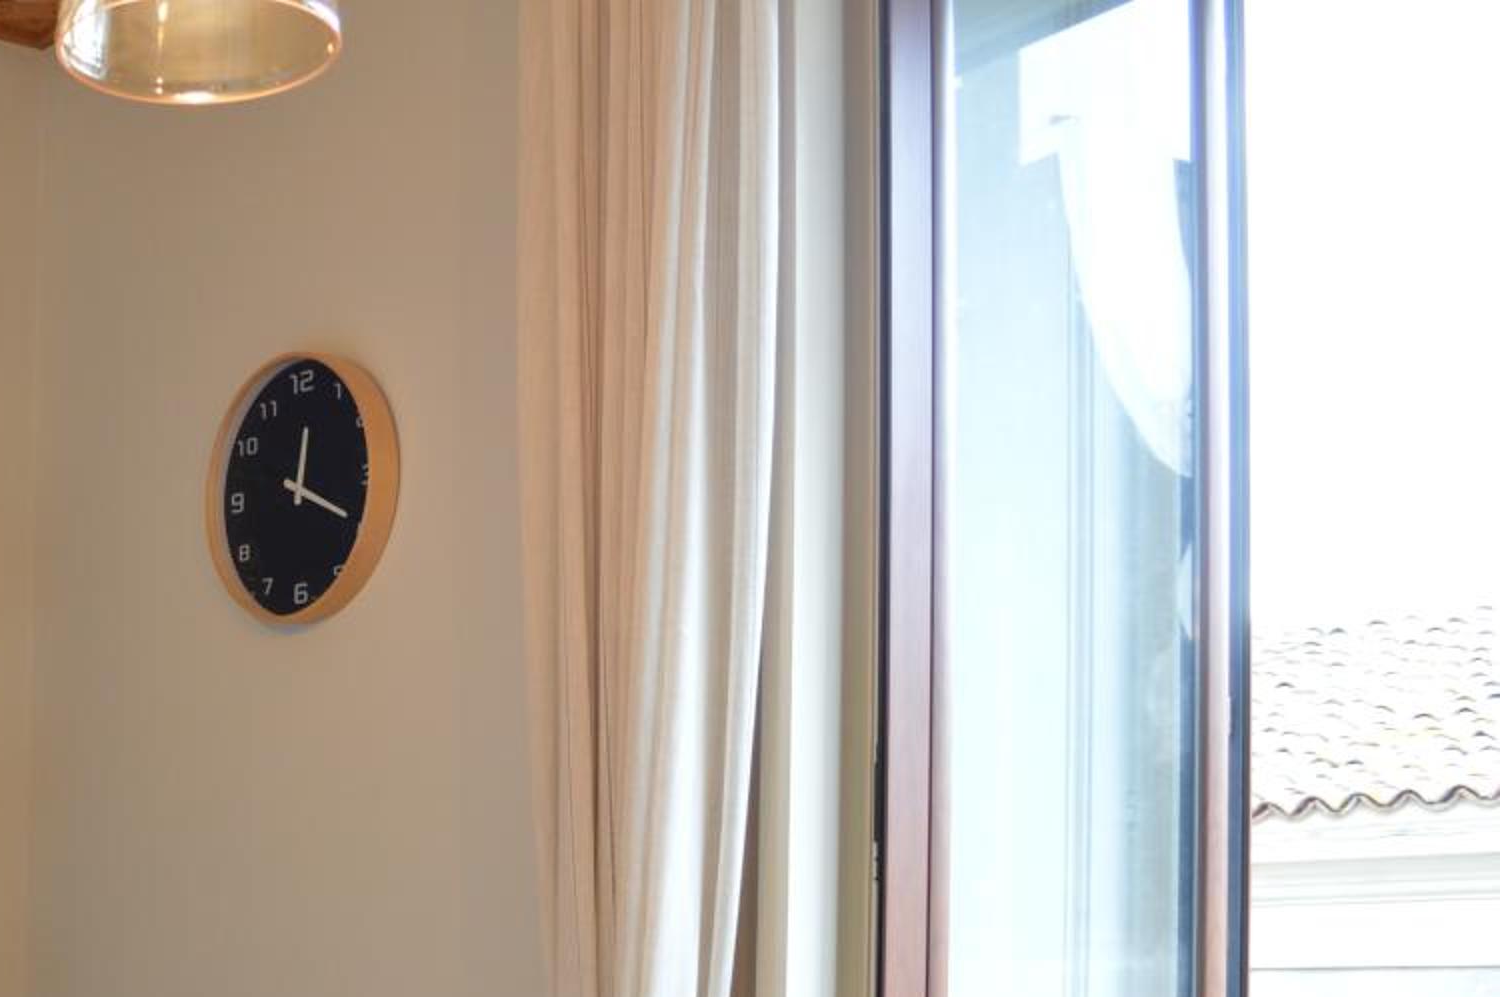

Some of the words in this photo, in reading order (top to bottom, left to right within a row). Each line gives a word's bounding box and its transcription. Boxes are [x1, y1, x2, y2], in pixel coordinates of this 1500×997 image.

[289, 369, 316, 395] 12
[259, 400, 278, 420] 11
[237, 436, 259, 456] 10
[231, 492, 245, 514] 9
[239, 544, 250, 562] 8
[262, 577, 274, 596] 7
[293, 582, 309, 605] 6
